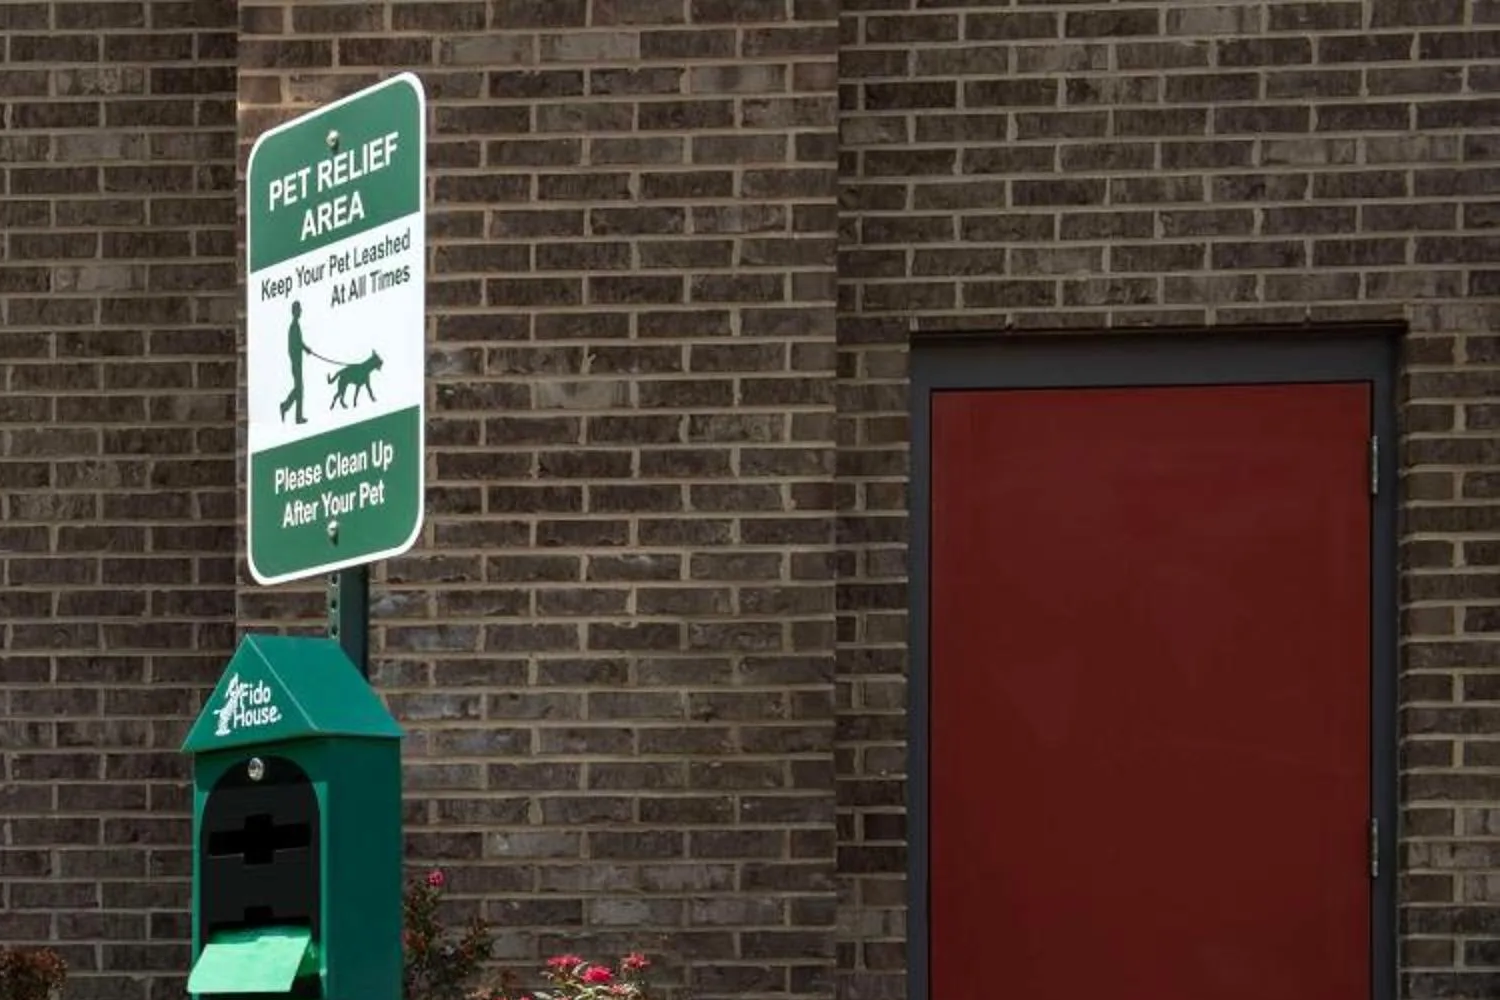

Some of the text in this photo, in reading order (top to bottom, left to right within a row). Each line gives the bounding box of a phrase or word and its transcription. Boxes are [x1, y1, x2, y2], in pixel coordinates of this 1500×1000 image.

[269, 132, 399, 212] PET RELIEF
[301, 191, 365, 241] AREA
[261, 227, 411, 302] Keep Your Pet Leashed
[330, 264, 411, 308] At All Times
[275, 440, 393, 494] Please Clean Up
[282, 480, 385, 529] After Your Pet
[239, 680, 272, 705] Fido
